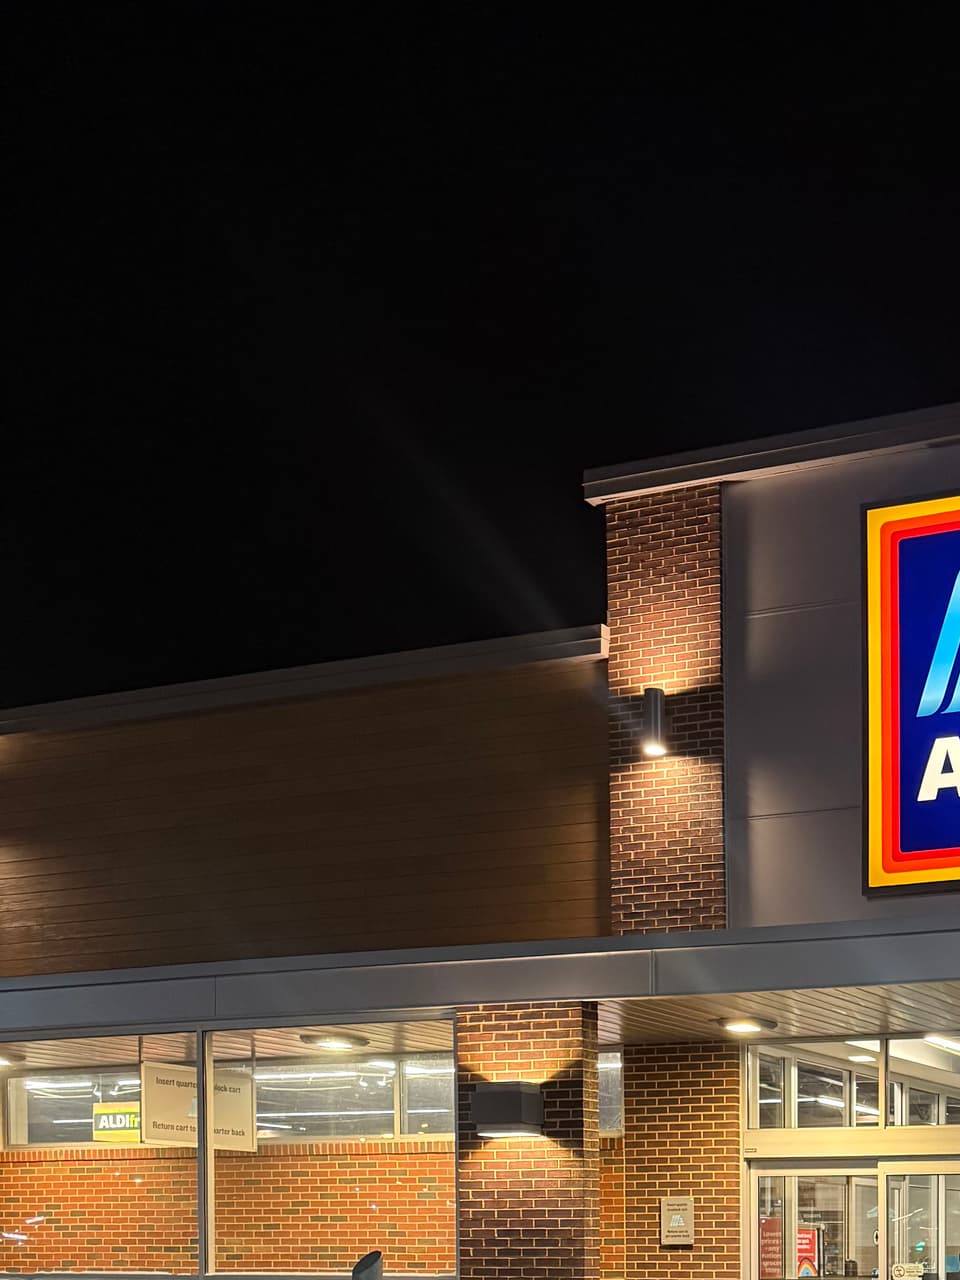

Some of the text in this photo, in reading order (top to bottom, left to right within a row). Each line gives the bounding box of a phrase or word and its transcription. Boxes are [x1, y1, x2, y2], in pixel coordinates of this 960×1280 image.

[156, 1076, 175, 1087] Insert
[176, 1078, 197, 1089] quarte
[228, 1086, 241, 1094] cart
[152, 1120, 175, 1131] Return
[175, 1122, 189, 1132] cart
[233, 1128, 246, 1137] back
